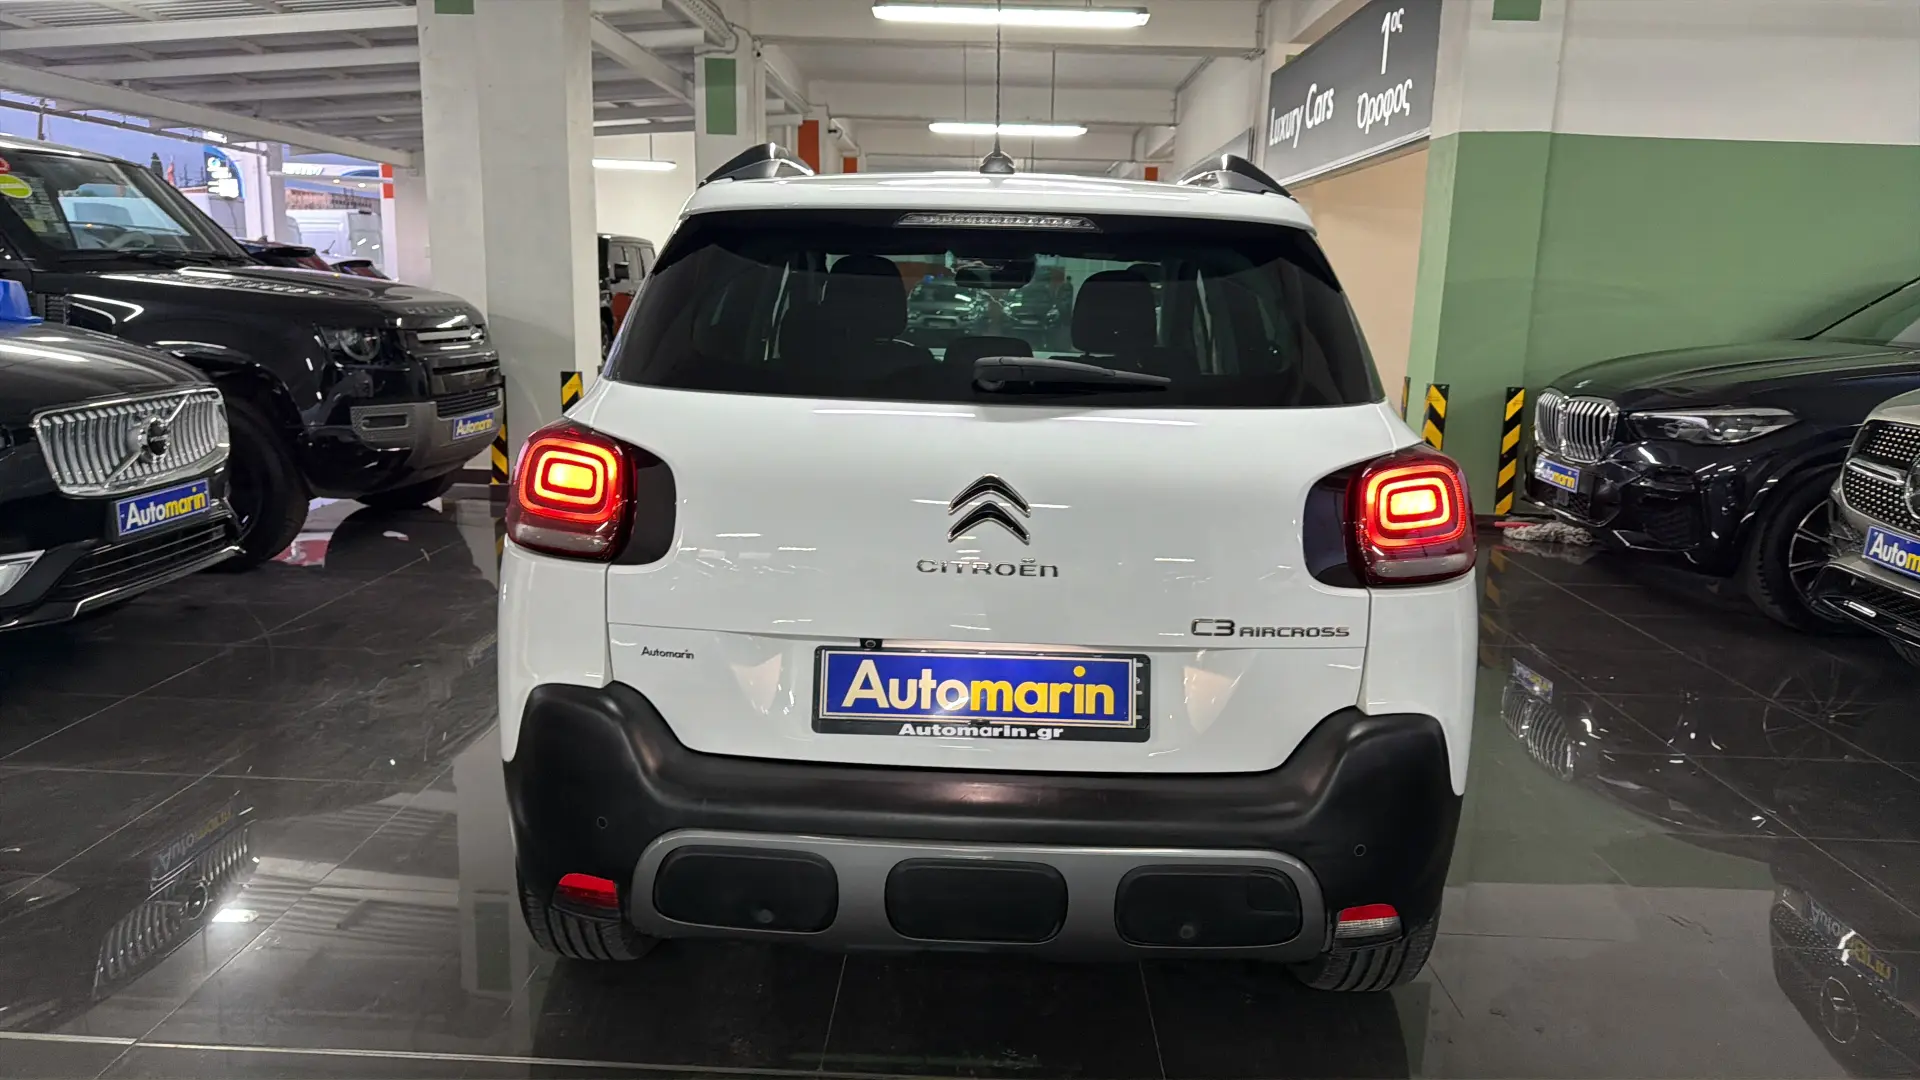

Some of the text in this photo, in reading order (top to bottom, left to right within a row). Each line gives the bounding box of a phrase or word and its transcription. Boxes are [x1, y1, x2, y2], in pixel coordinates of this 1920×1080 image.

[1269, 83, 1335, 148] Luxury Cars
[125, 487, 207, 530] Automarin
[1191, 618, 1350, 638] C3 AIRCROSS
[641, 646, 694, 659] Automarin
[841, 659, 1115, 715] Automarin
[899, 723, 1064, 740] Automarin.gr
